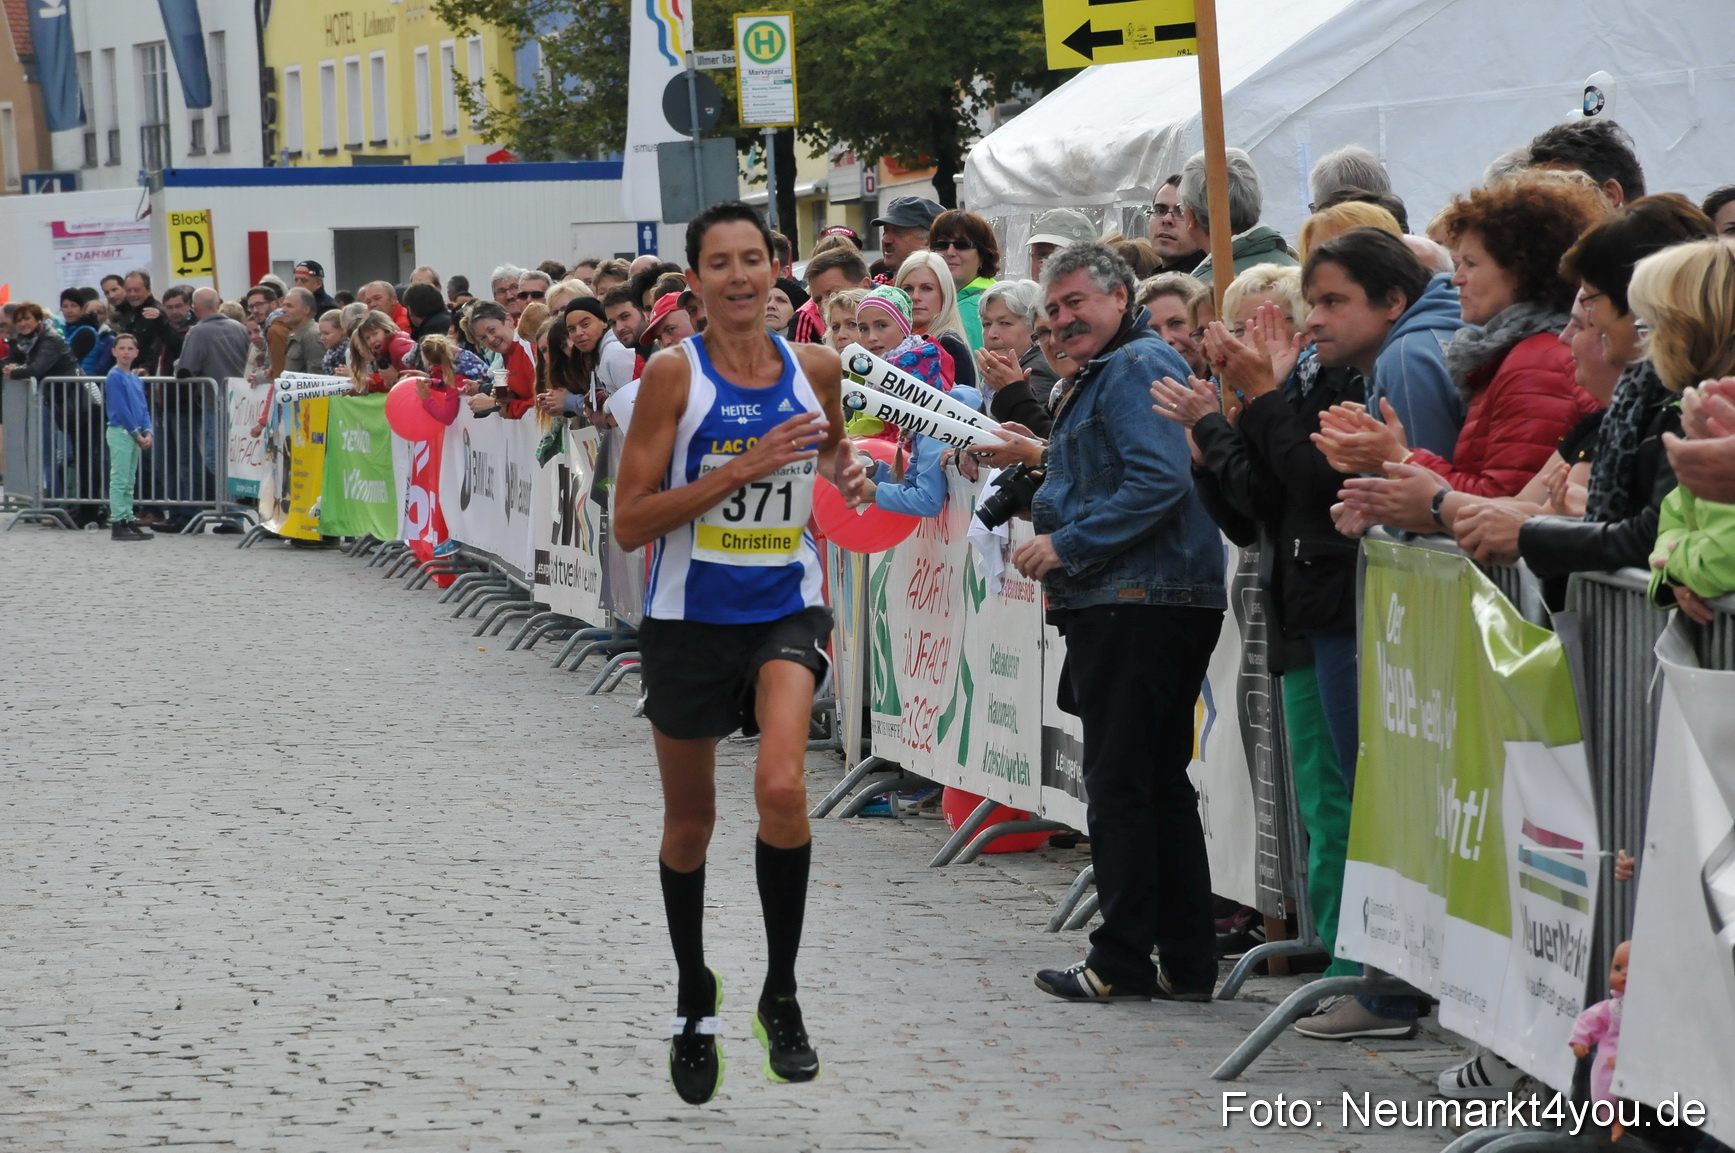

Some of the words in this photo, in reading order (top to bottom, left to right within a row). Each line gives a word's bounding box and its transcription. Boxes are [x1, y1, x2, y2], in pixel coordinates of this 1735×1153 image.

[325, 11, 355, 47] HOTEL
[171, 213, 208, 226] Block
[180, 231, 204, 263] D
[74, 249, 124, 261] DAHMIT
[296, 381, 320, 390] BMW
[880, 371, 934, 407] BMW
[297, 390, 321, 401] BMW
[720, 404, 762, 416] HEITEC
[875, 404, 930, 433] BMW
[711, 440, 743, 453] LAC
[722, 481, 793, 523] 371
[721, 532, 792, 550] Christine
